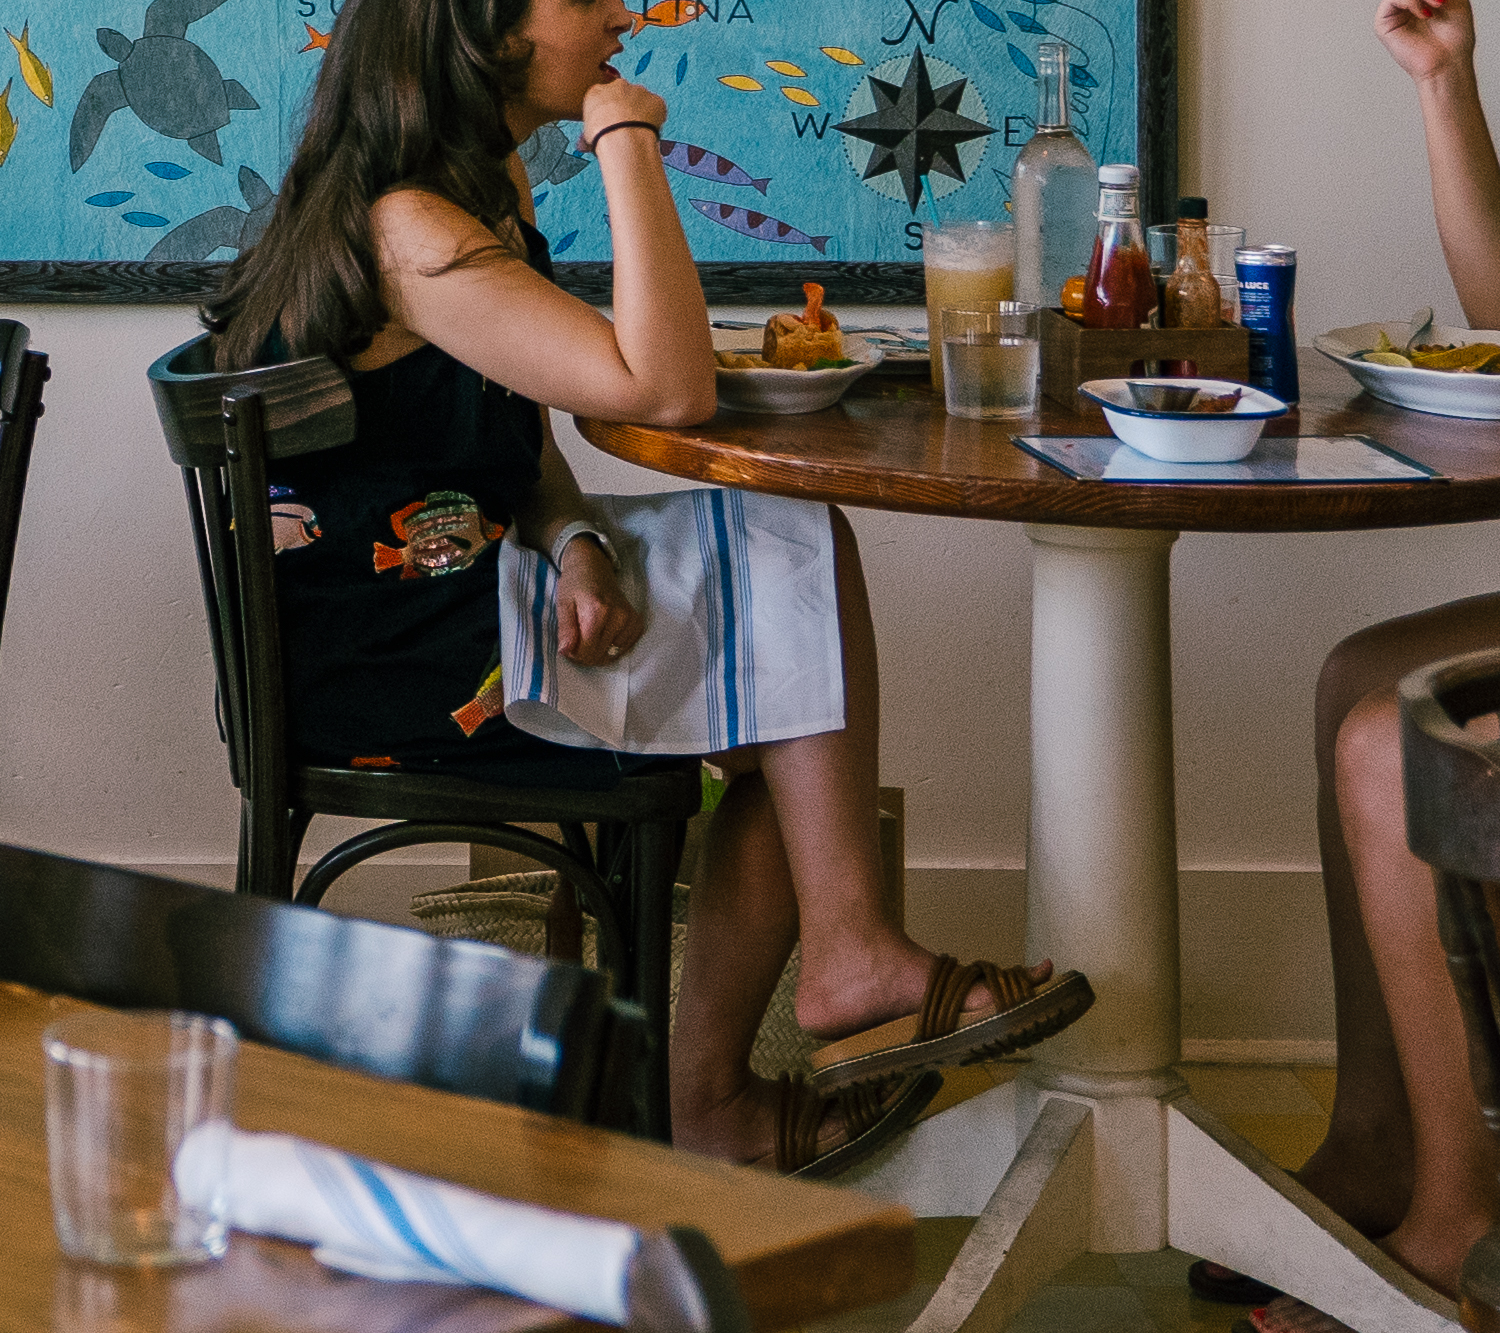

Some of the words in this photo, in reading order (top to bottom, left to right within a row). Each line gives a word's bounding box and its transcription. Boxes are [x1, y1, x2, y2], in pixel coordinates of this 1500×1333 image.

[790, 110, 833, 141] W
[1004, 115, 1028, 148] E
[903, 221, 924, 252] S
